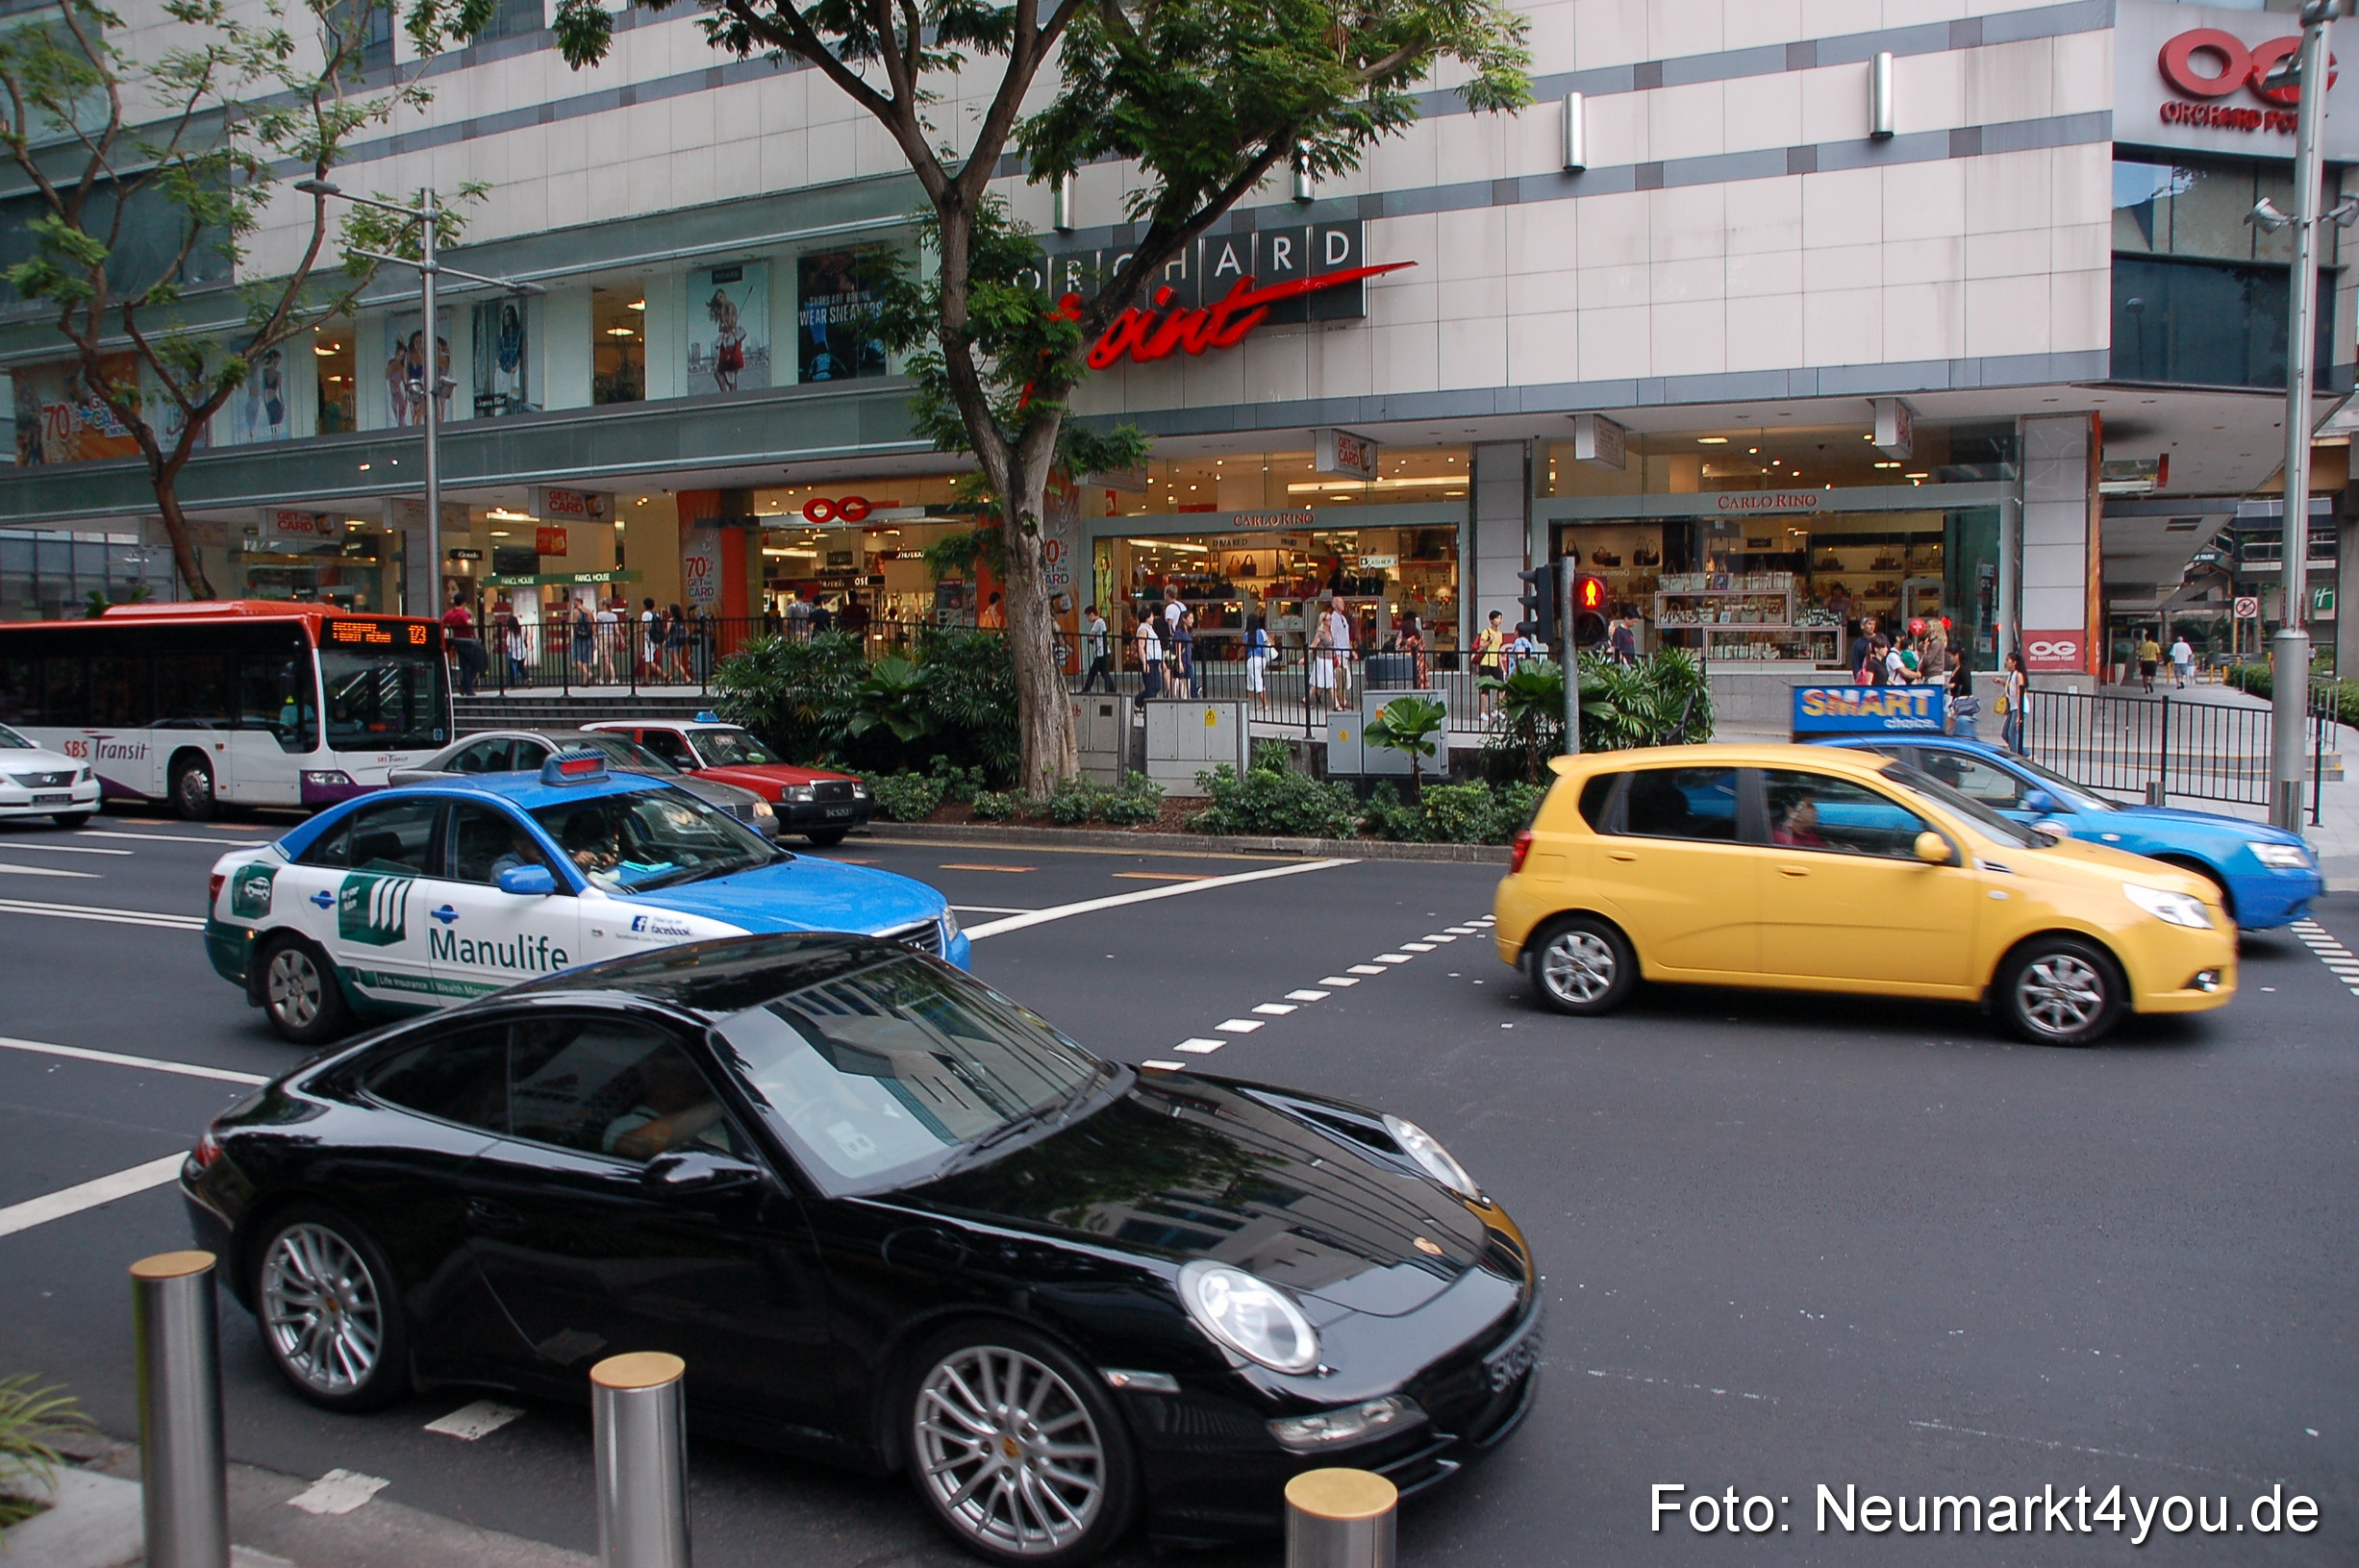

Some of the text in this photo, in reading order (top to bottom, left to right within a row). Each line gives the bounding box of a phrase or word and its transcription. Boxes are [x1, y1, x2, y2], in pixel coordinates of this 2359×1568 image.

[2160, 100, 2262, 133] ORCHARD
[1014, 230, 1350, 293] ORCHARD
[809, 290, 870, 306] SHOES ARE BORING
[799, 309, 827, 327] WEAR
[1338, 449, 1359, 465] CARD
[548, 490, 570, 502] GET
[1718, 493, 1817, 510] CARLO RINO
[548, 501, 585, 513] CARD
[803, 496, 870, 523] OG
[277, 510, 300, 522] GET
[1233, 512, 1315, 527] CARLO RINO
[277, 520, 314, 532] CARD
[688, 578, 703, 587] GET
[1044, 573, 1069, 585] ARD
[688, 587, 714, 597] CARD
[2029, 640, 2076, 656] OG
[1801, 688, 1936, 717] SMART
[64, 734, 150, 761] SBS Transit
[430, 928, 569, 971] Manulife
